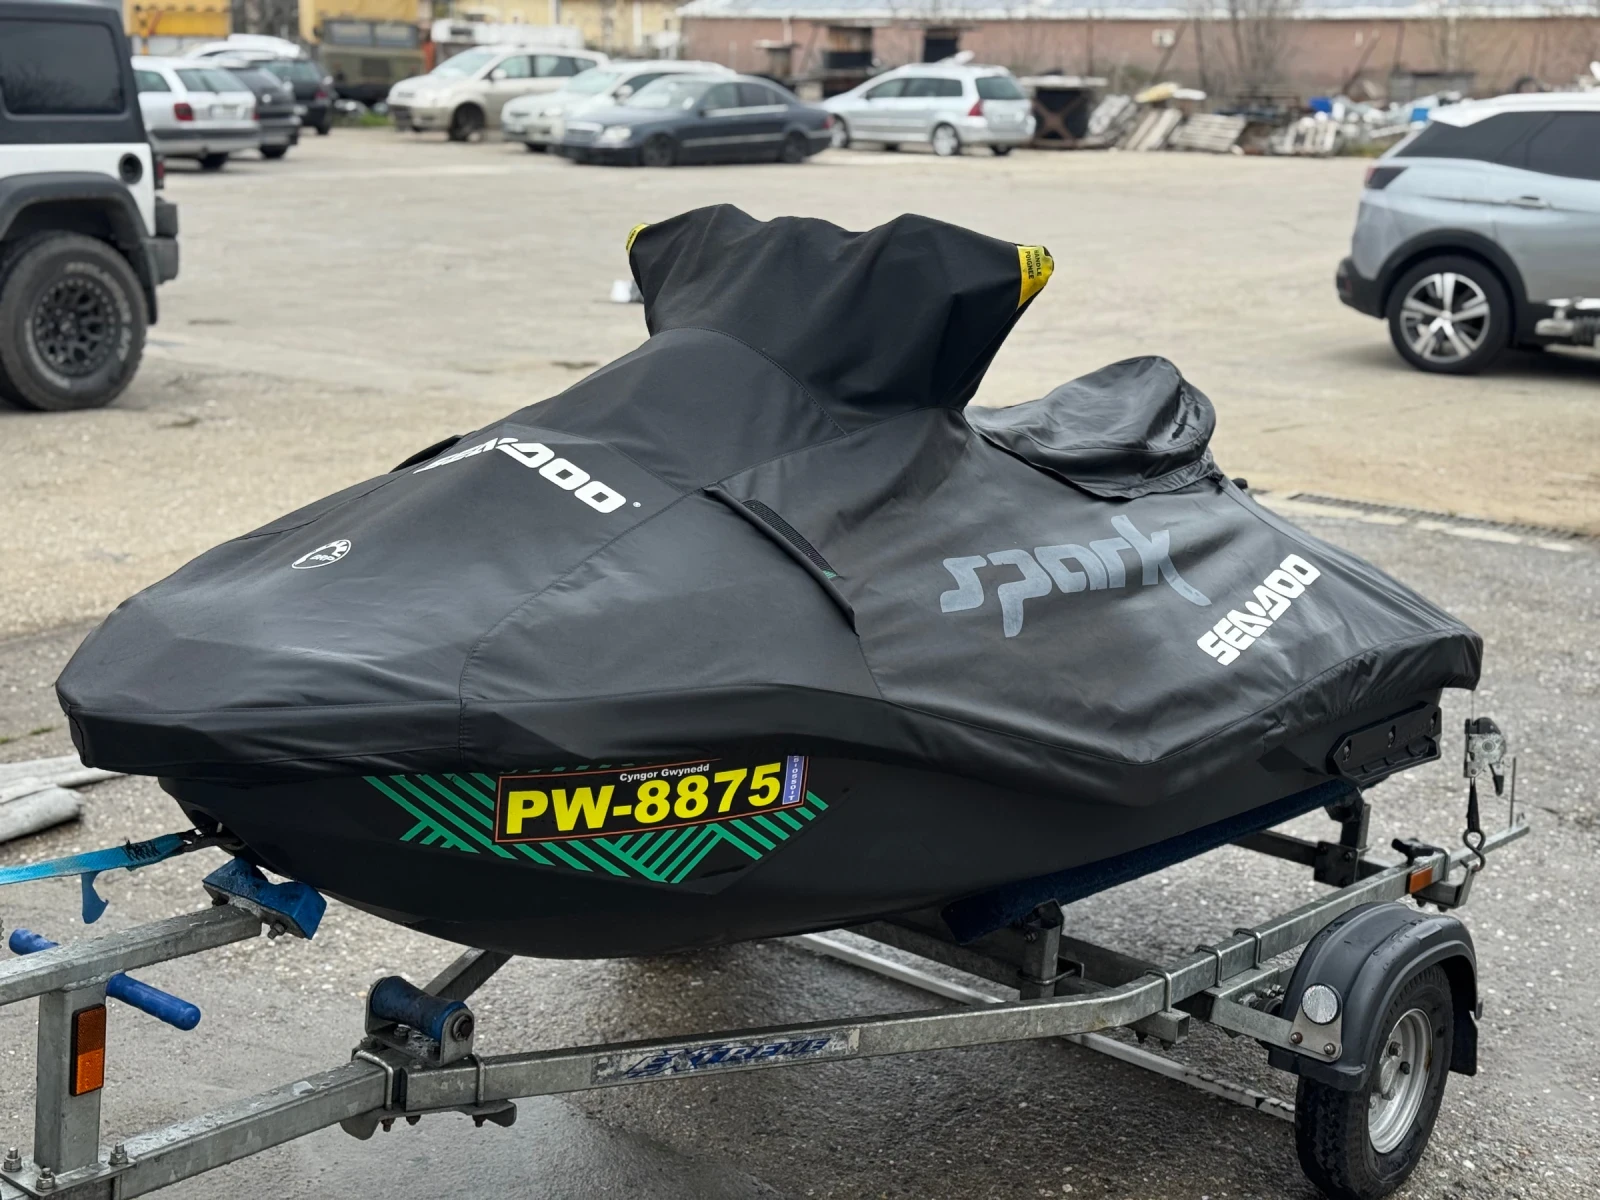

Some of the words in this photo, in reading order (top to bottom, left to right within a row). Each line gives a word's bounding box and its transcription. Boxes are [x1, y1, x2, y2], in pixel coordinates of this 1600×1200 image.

[619, 770, 659, 783] Cyngor
[660, 763, 710, 777] Gwynedd
[506, 762, 781, 835] PW-8875
